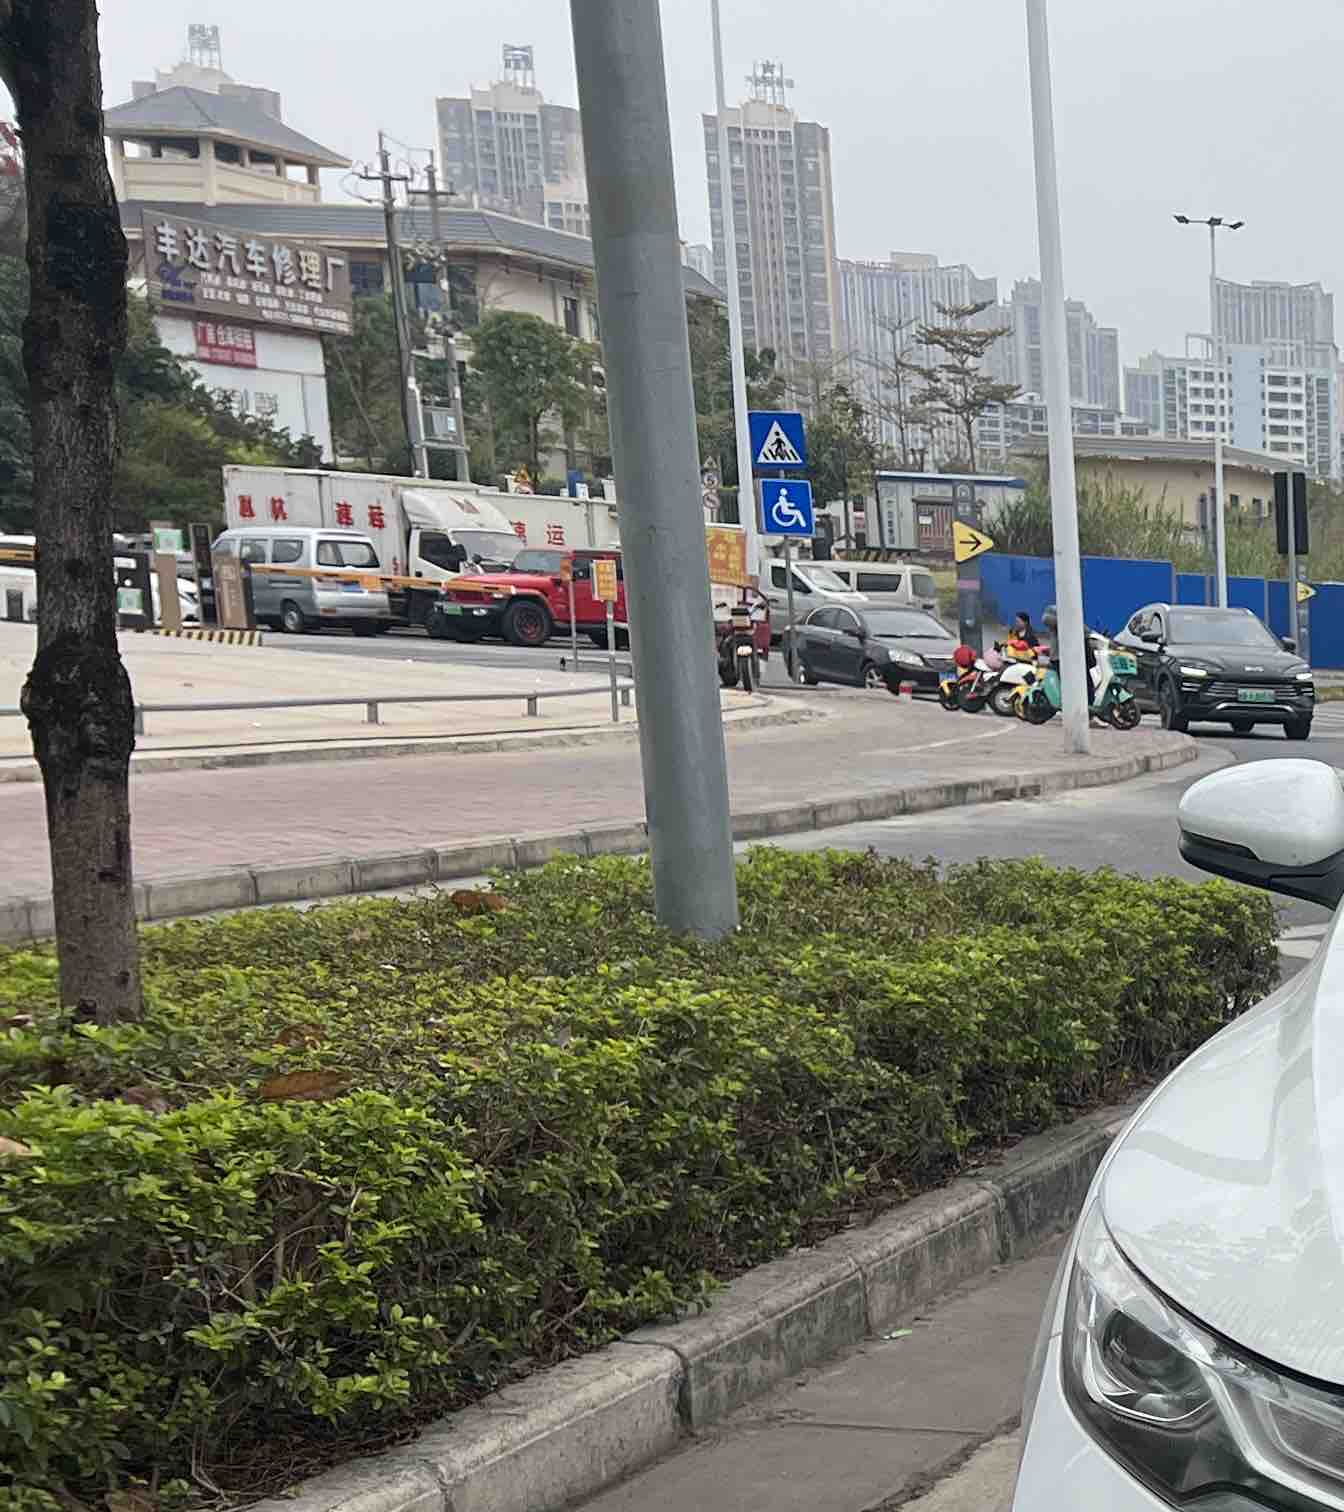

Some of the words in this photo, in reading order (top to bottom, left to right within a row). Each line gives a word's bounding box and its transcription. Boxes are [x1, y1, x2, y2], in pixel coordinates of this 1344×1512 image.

[155, 219, 345, 292] 丰达汽车修理厂
